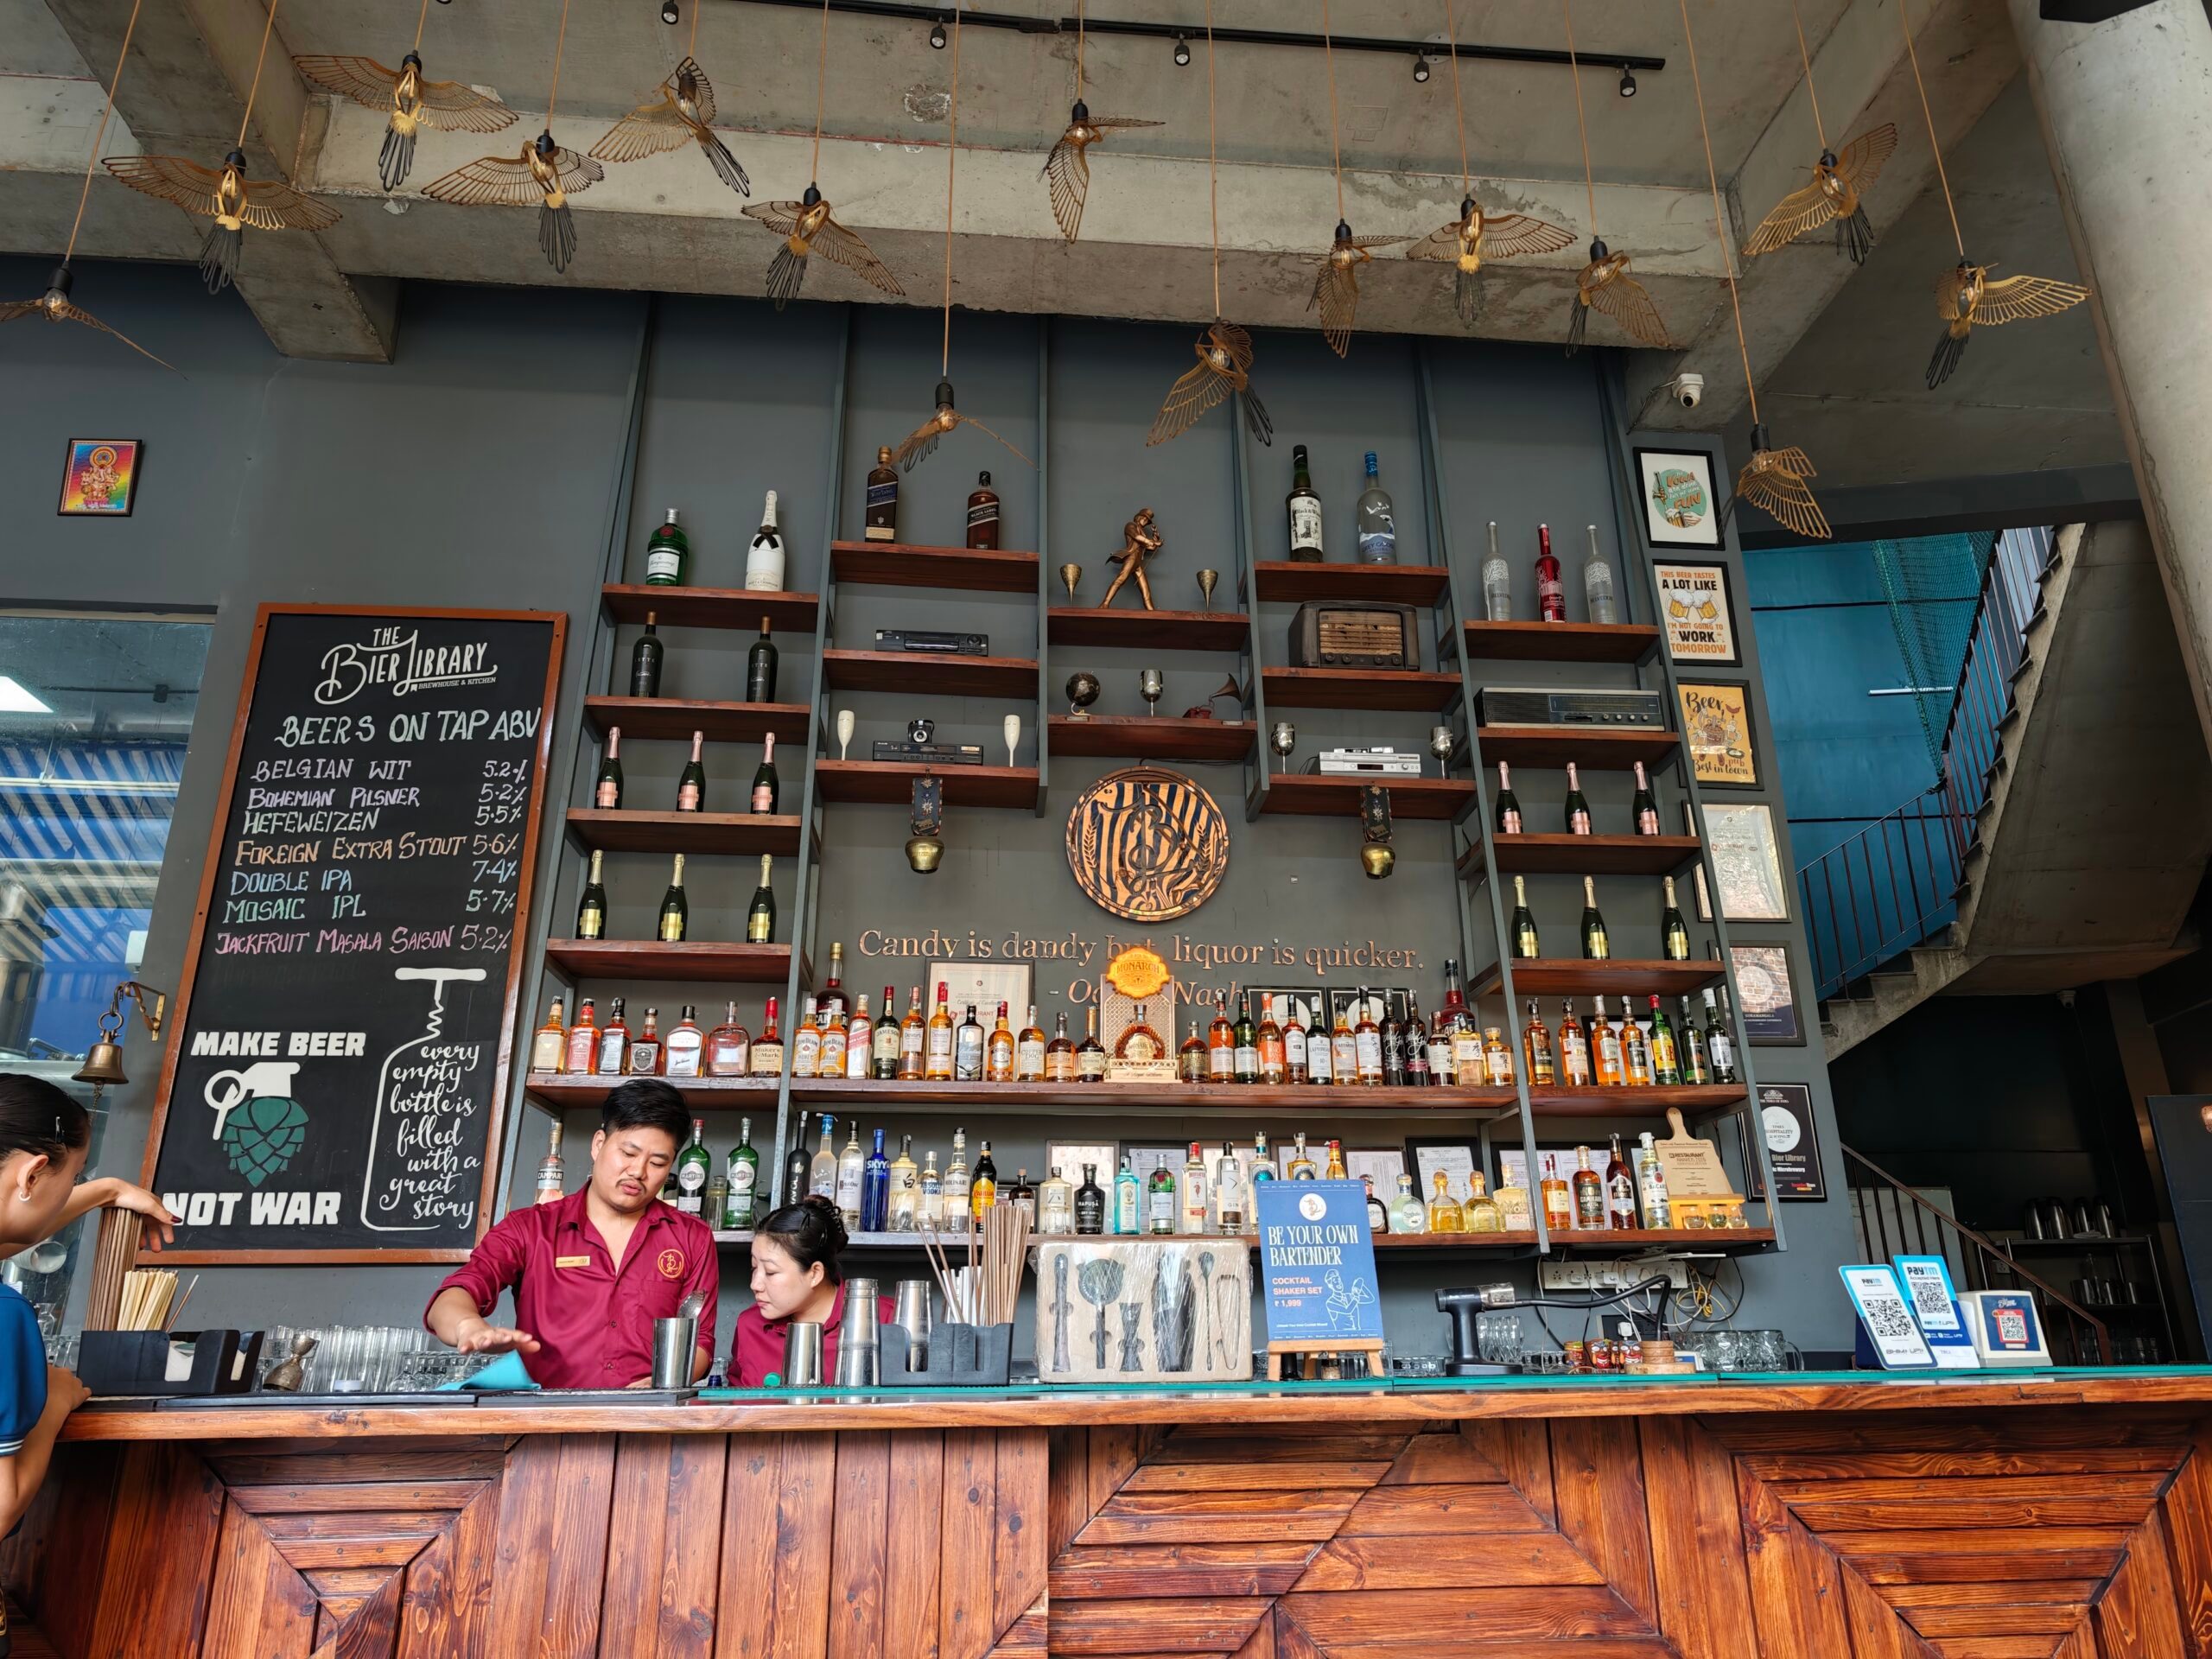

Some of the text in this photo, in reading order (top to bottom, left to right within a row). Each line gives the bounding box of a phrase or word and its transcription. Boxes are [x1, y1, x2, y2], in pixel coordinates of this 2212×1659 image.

[1662, 579, 1717, 590] A LOT LIKE
[373, 626, 401, 647] THE
[1670, 643, 1726, 654] TOMORROW
[1678, 631, 1715, 643] WORK
[418, 679, 460, 690] BREWHOUSE
[467, 677, 497, 685] KITCHEN
[1686, 691, 1723, 714] Beer
[274, 715, 376, 747] BEERS
[389, 712, 429, 743] ON
[437, 710, 489, 741] TAP
[251, 758, 353, 783] BELGIAN
[369, 760, 411, 780] WIT
[1713, 764, 1724, 773] in
[1725, 764, 1749, 775] town
[247, 787, 334, 810] BOHEMIAN
[350, 785, 421, 808] PILSNER
[243, 808, 381, 836] HEFEWEIZEN
[234, 839, 318, 867] FOREIGN
[332, 834, 392, 861] EXTRA
[397, 831, 467, 860] STOUT
[230, 869, 309, 896] DOUBLE
[321, 868, 353, 892] IPA
[222, 897, 305, 924] MOSAIC
[332, 893, 366, 919] IPL
[214, 931, 310, 955] JACKFRUIT
[315, 927, 382, 953] MASALA
[389, 925, 455, 951] SAISON
[859, 929, 960, 958] Candy
[969, 931, 992, 958] is
[1002, 930, 1097, 967] dandy
[1173, 935, 1263, 969] liquor
[1273, 938, 1296, 964] is
[1116, 962, 1160, 974] MONARCH
[1173, 982, 1243, 1007] Nash
[1445, 1023, 1473, 1037] APEL
[190, 1032, 366, 1057] MAKE BEER
[420, 1044, 480, 1071] every
[391, 1059, 461, 1093] empty
[389, 1088, 478, 1118] bottle is
[397, 1116, 463, 1158] filled
[406, 1145, 480, 1172] with a
[867, 1160, 887, 1169] SKYY
[537, 1171, 563, 1180] CAMPARI
[378, 1169, 456, 1211] great
[162, 1192, 341, 1225] NOT WAR
[412, 1193, 475, 1230] story
[1268, 1224, 1358, 1246] BE YOUR OWN
[1271, 1247, 1343, 1267] BARTENDER
